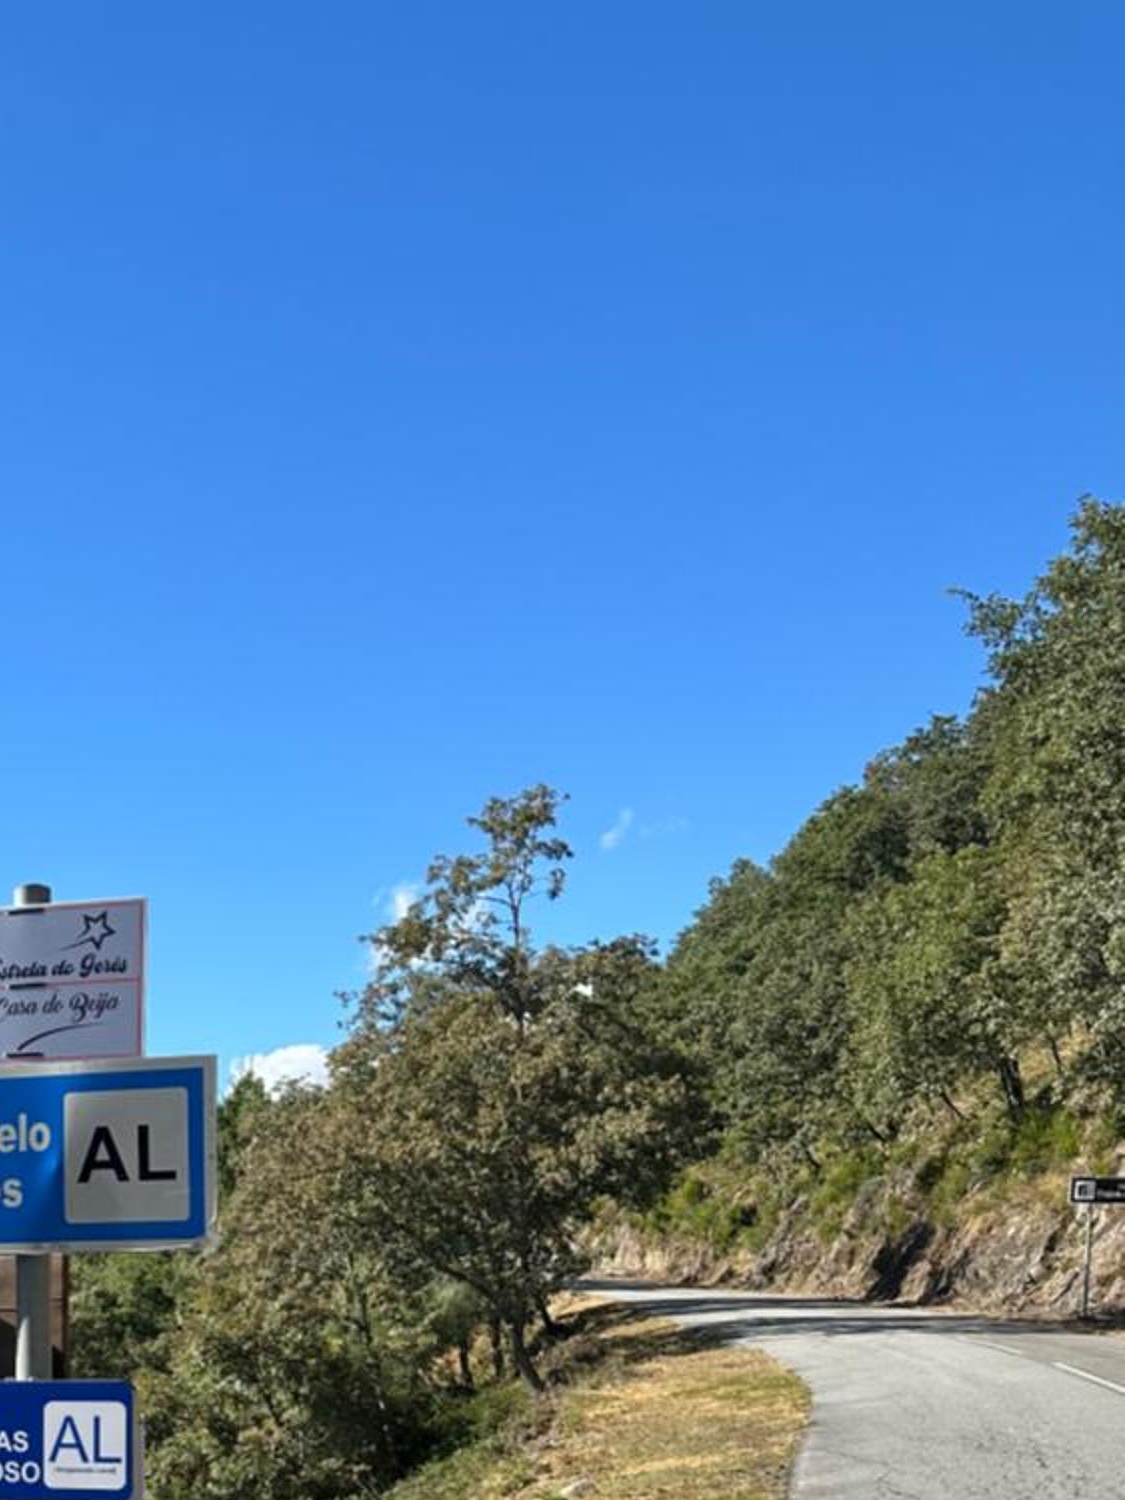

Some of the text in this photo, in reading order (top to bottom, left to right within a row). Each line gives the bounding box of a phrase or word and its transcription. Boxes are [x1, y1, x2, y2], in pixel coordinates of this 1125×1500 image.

[51, 960, 75, 975] do
[77, 1125, 177, 1183] AL
[49, 1415, 122, 1464] AL
